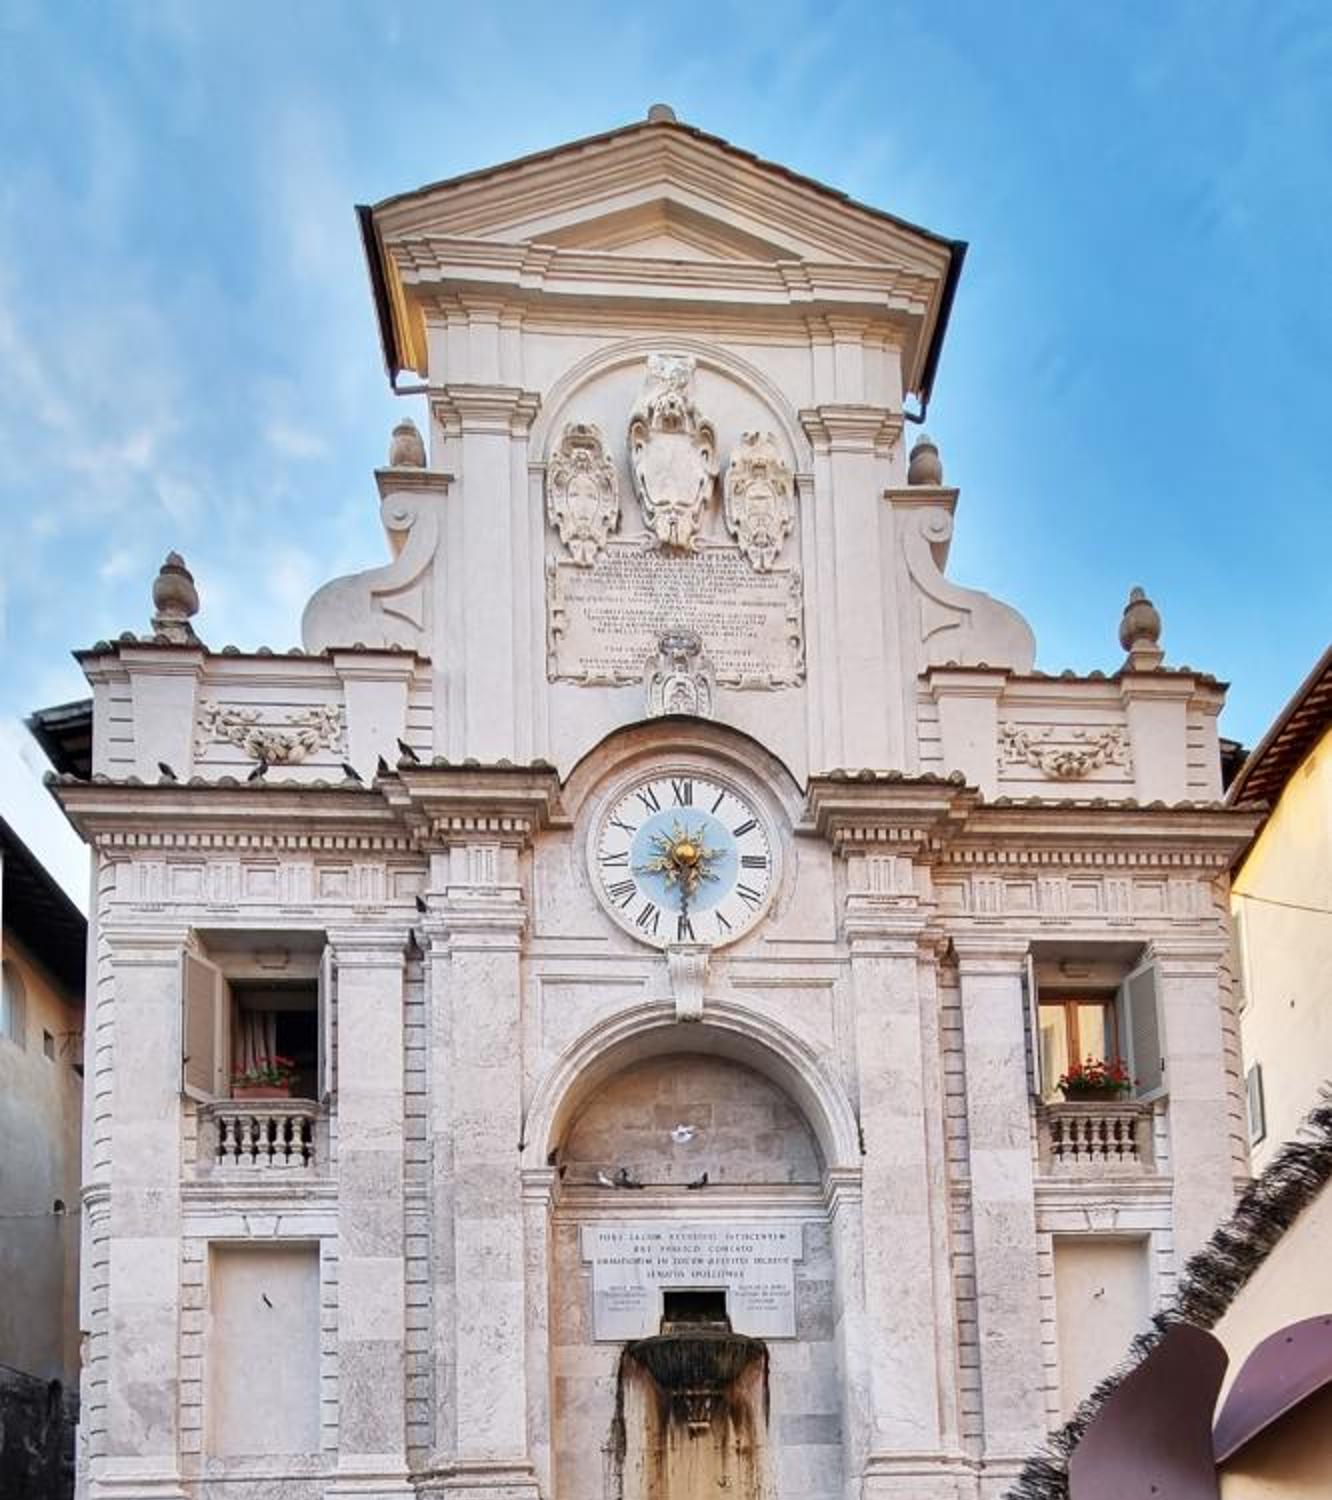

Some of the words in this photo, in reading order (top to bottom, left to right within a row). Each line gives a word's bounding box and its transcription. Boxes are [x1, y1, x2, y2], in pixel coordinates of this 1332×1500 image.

[636, 785, 661, 815] XI
[672, 777, 694, 807] XII
[609, 814, 638, 838] X
